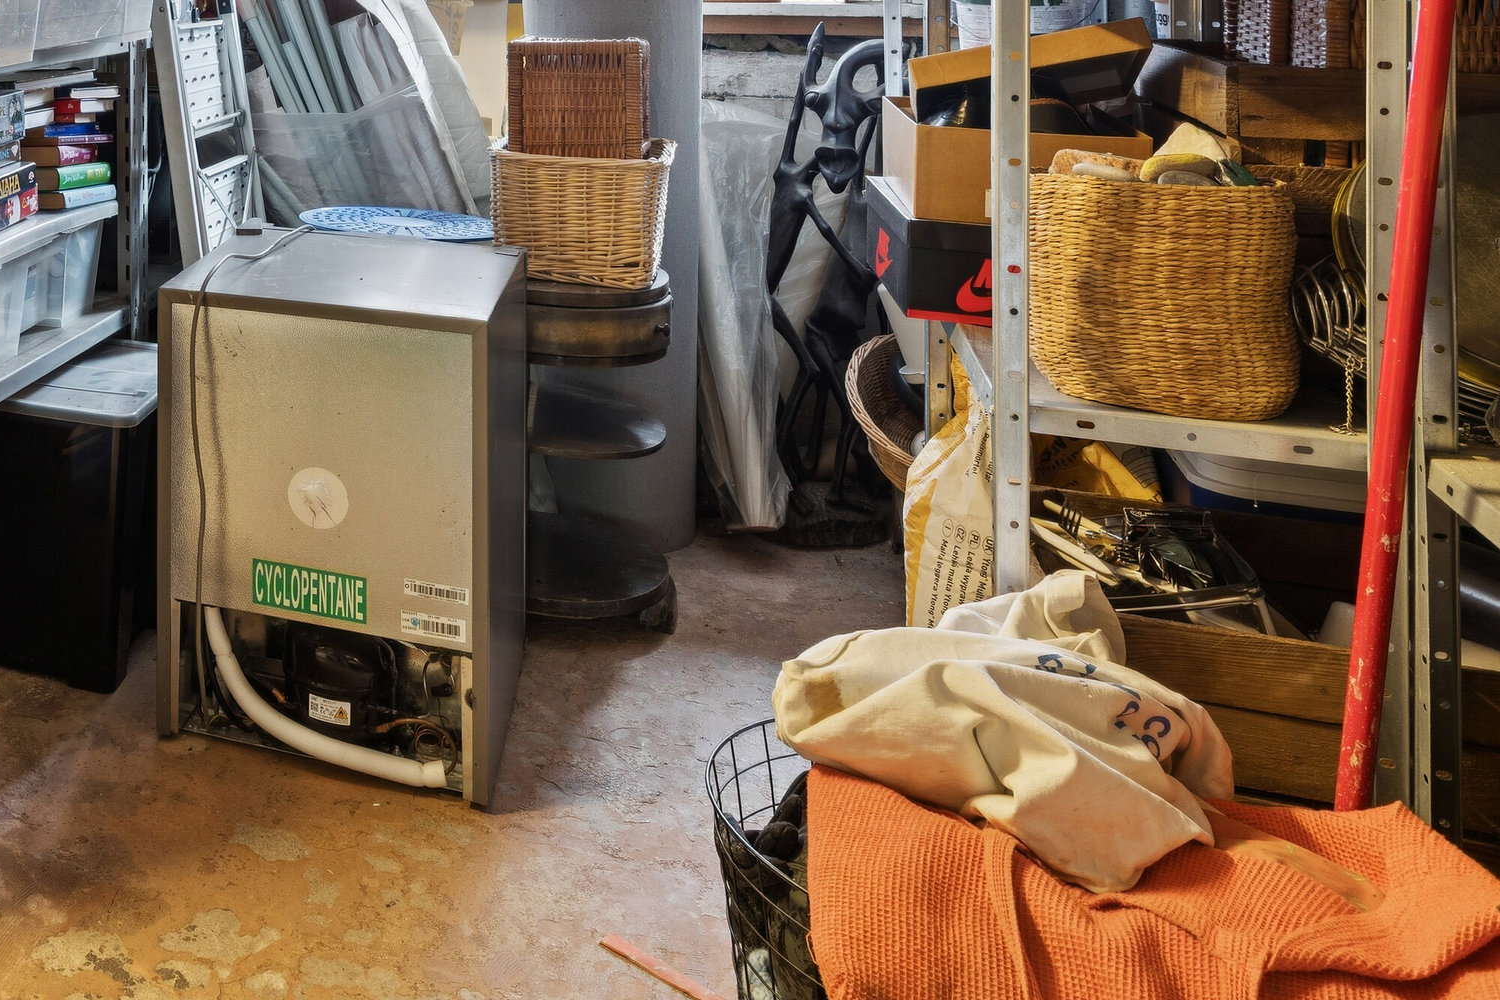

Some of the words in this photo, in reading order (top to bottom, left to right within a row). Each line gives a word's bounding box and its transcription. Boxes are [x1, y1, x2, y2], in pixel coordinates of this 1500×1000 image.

[956, 527, 965, 540] CZ
[970, 533, 979, 545] PL
[937, 539, 949, 560] Malta
[985, 538, 994, 553] UK
[933, 561, 943, 591] leggera
[946, 568, 955, 592] malta
[255, 562, 364, 621] CYCLOPENTANE
[973, 581, 987, 602] Multi
